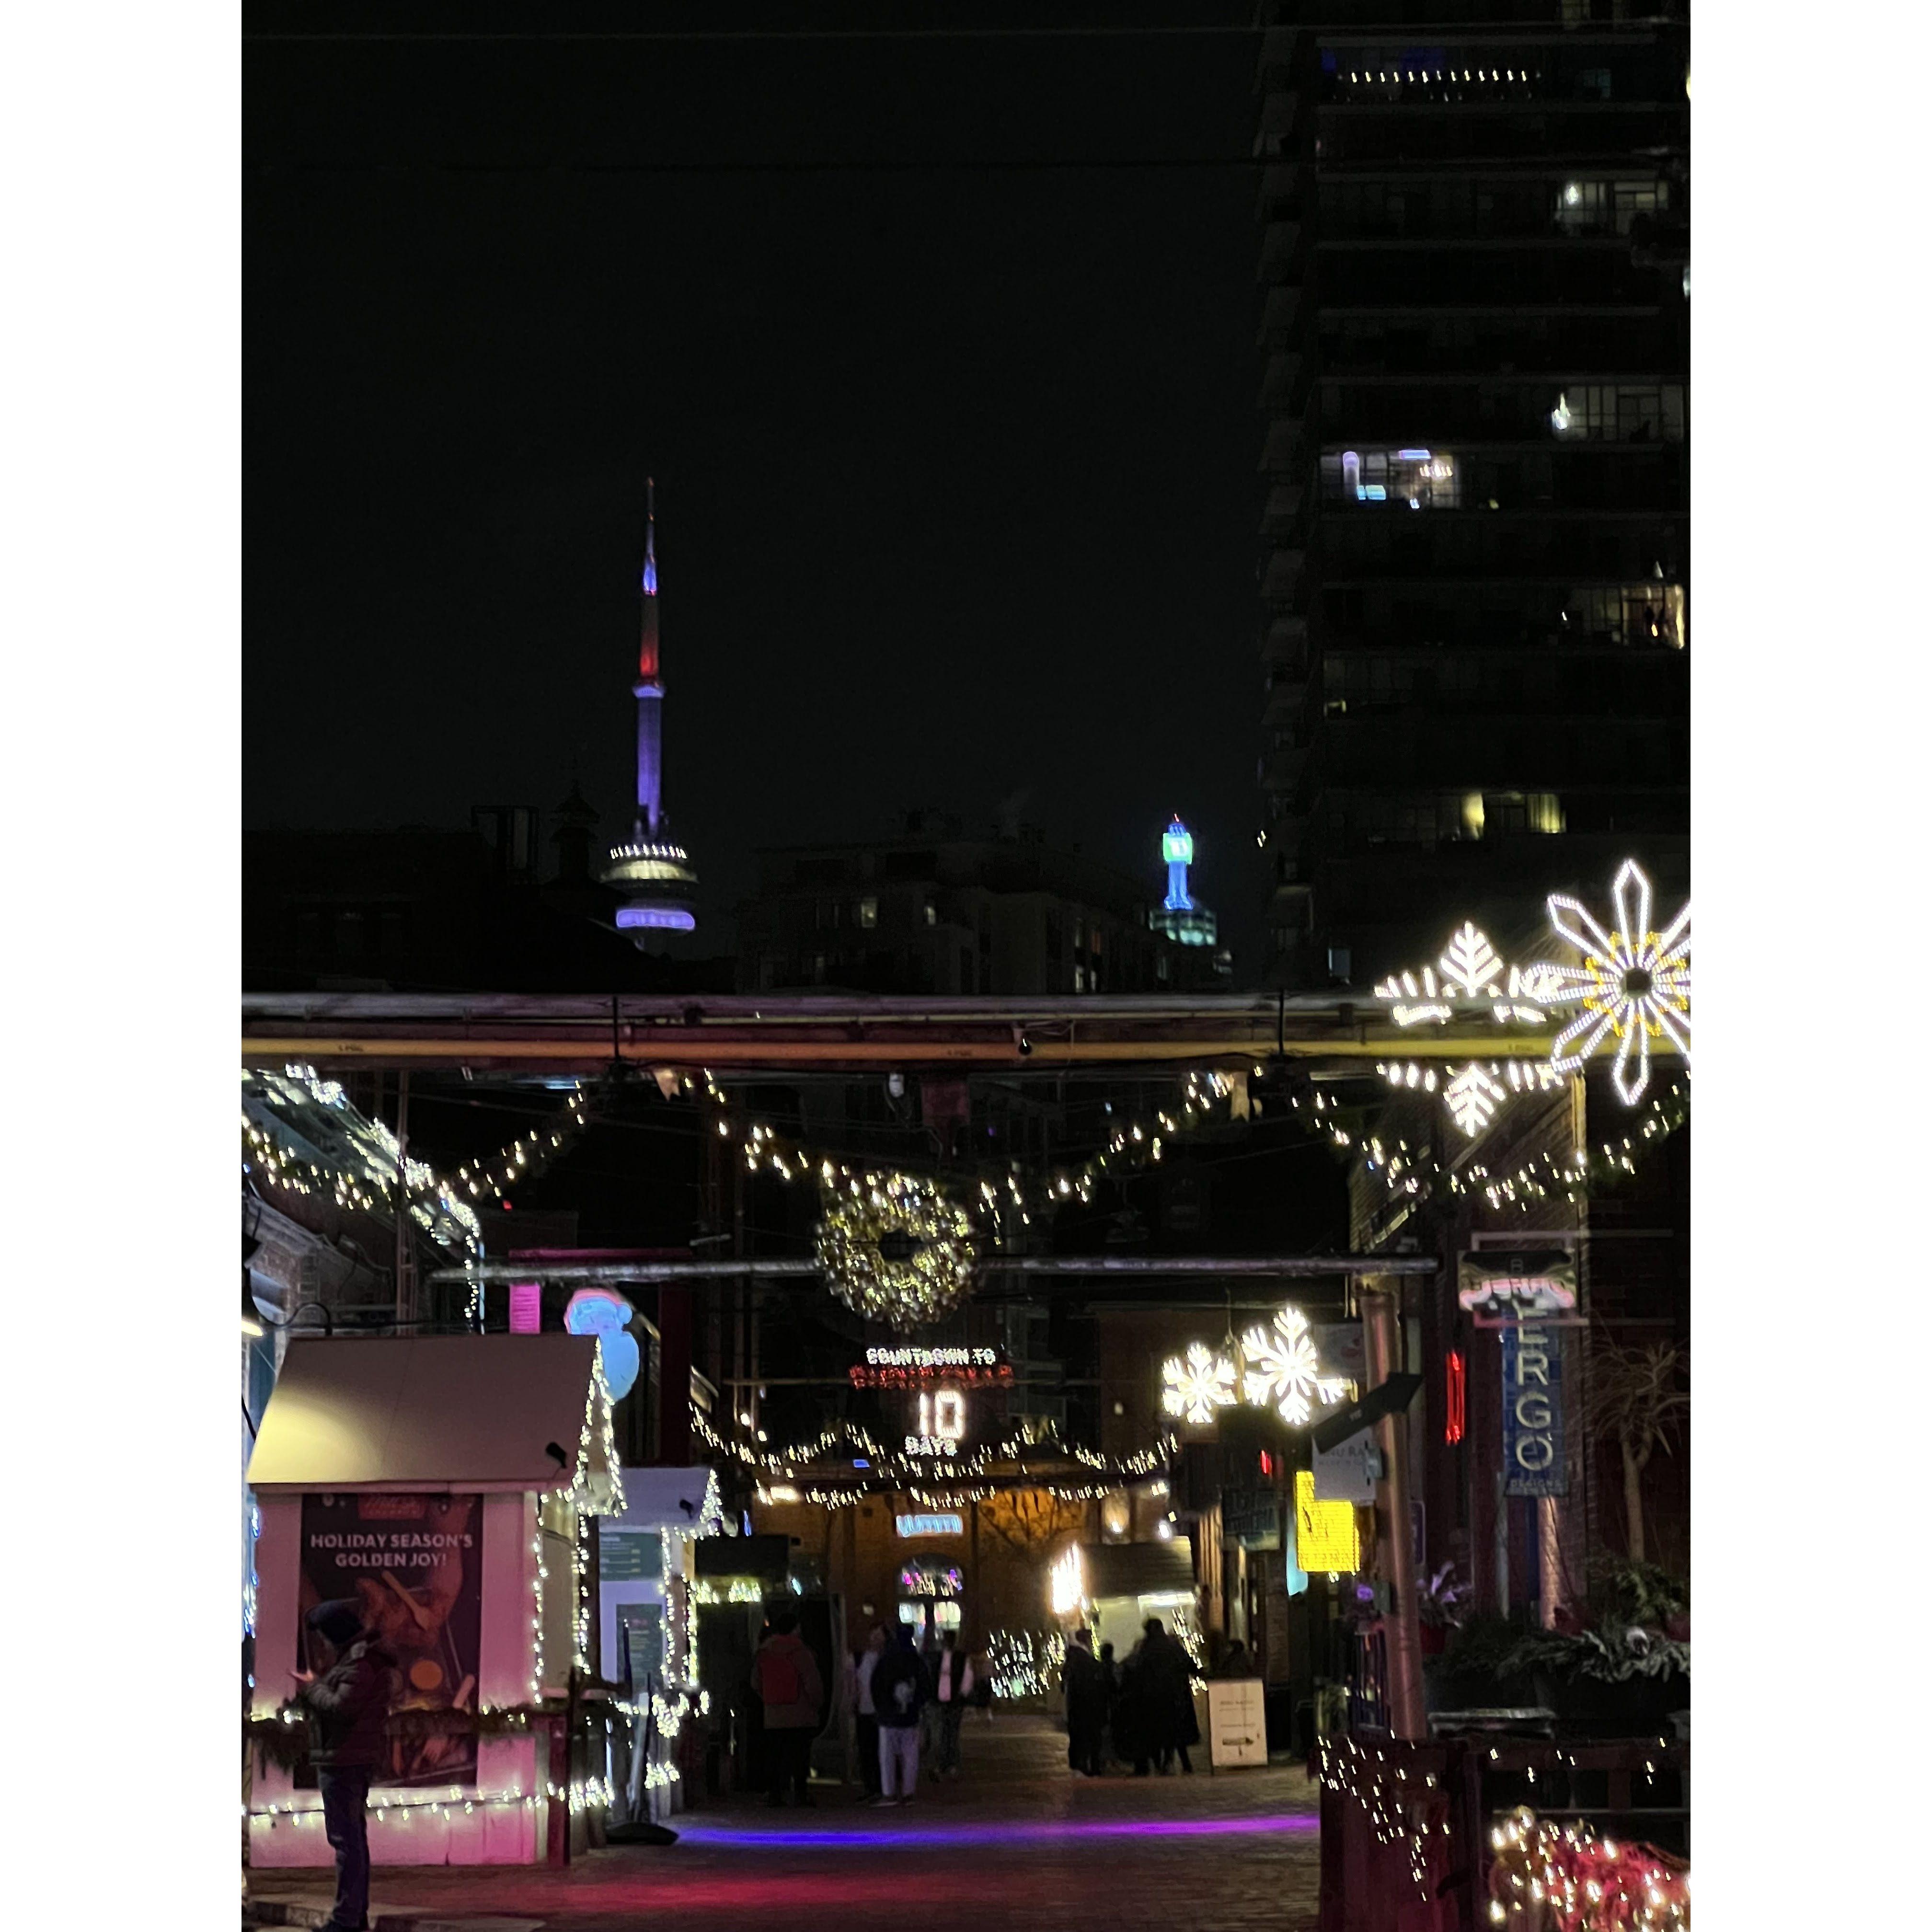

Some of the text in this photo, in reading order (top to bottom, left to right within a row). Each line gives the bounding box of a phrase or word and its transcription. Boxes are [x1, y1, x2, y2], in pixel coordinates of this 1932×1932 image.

[920, 1391, 964, 1440] 10
[310, 1533, 472, 1548] HOLIDAY SEASON'S
[335, 1552, 447, 1567] GOLDEN JOY!
